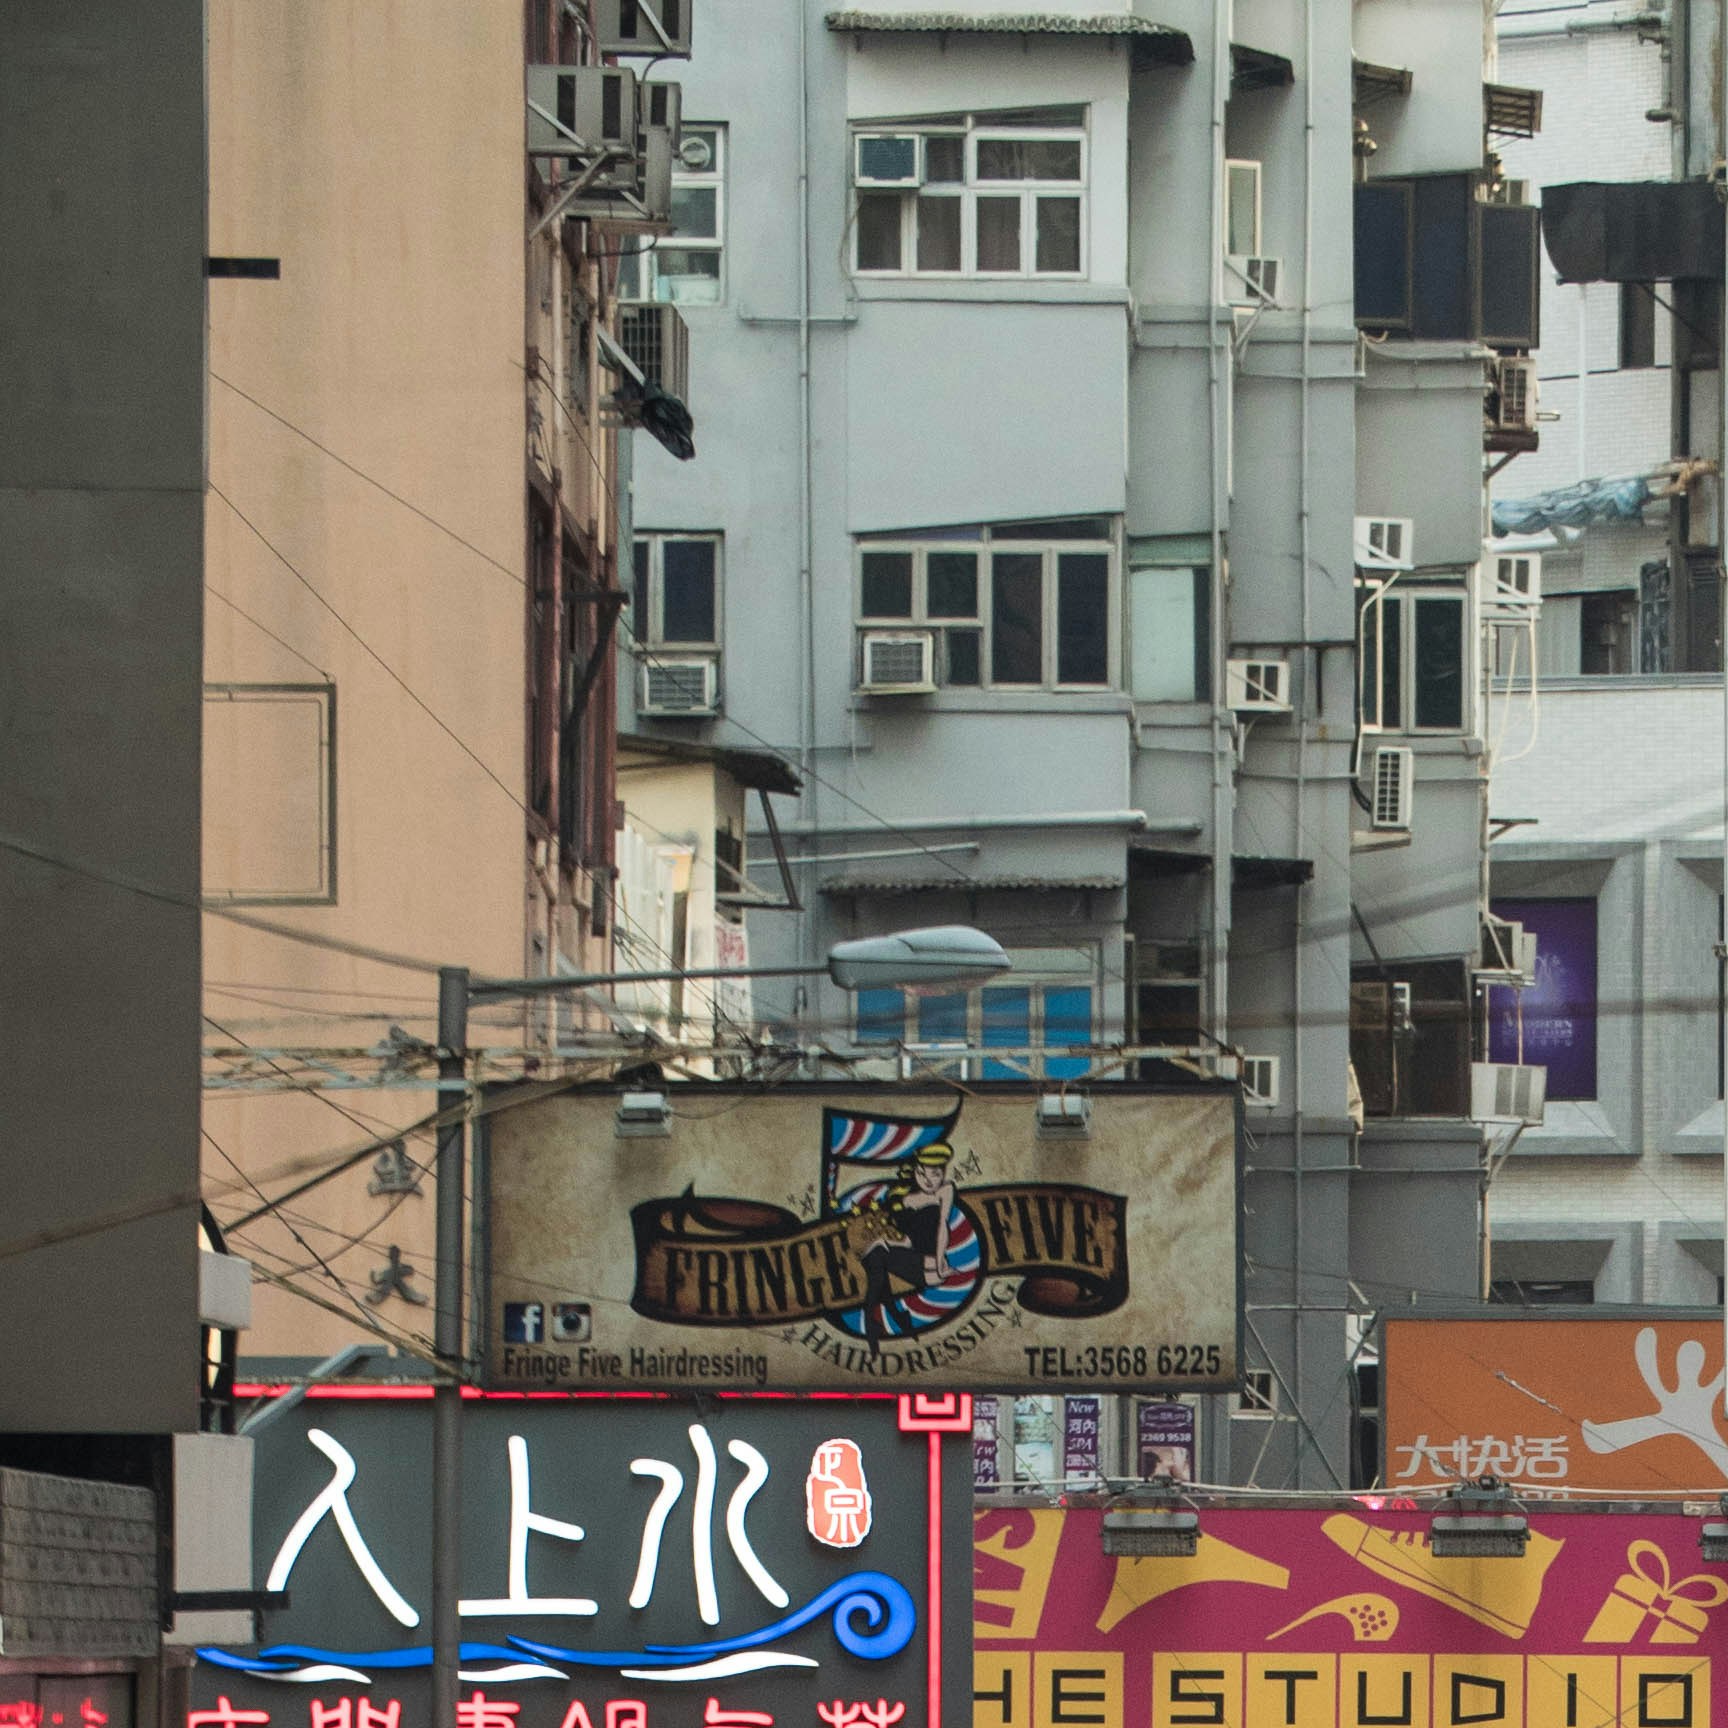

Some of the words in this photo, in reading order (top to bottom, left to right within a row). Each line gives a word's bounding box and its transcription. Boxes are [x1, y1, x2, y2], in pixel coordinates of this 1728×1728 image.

[664, 1233, 859, 1317] FRINGE
[981, 1196, 1108, 1270] FIVE
[799, 1278, 1020, 1379] HAIRDRESSING
[503, 1347, 572, 1384] Fringe
[577, 1346, 624, 1377] Five
[629, 1346, 769, 1385] Hairdressing
[1024, 1345, 1148, 1378] TEL:3568
[1156, 1344, 1222, 1376] 6225
[1395, 1434, 1569, 1478] 大快活
[974, 1668, 1105, 1725] HE
[1169, 1668, 1696, 1728] STUDIO
